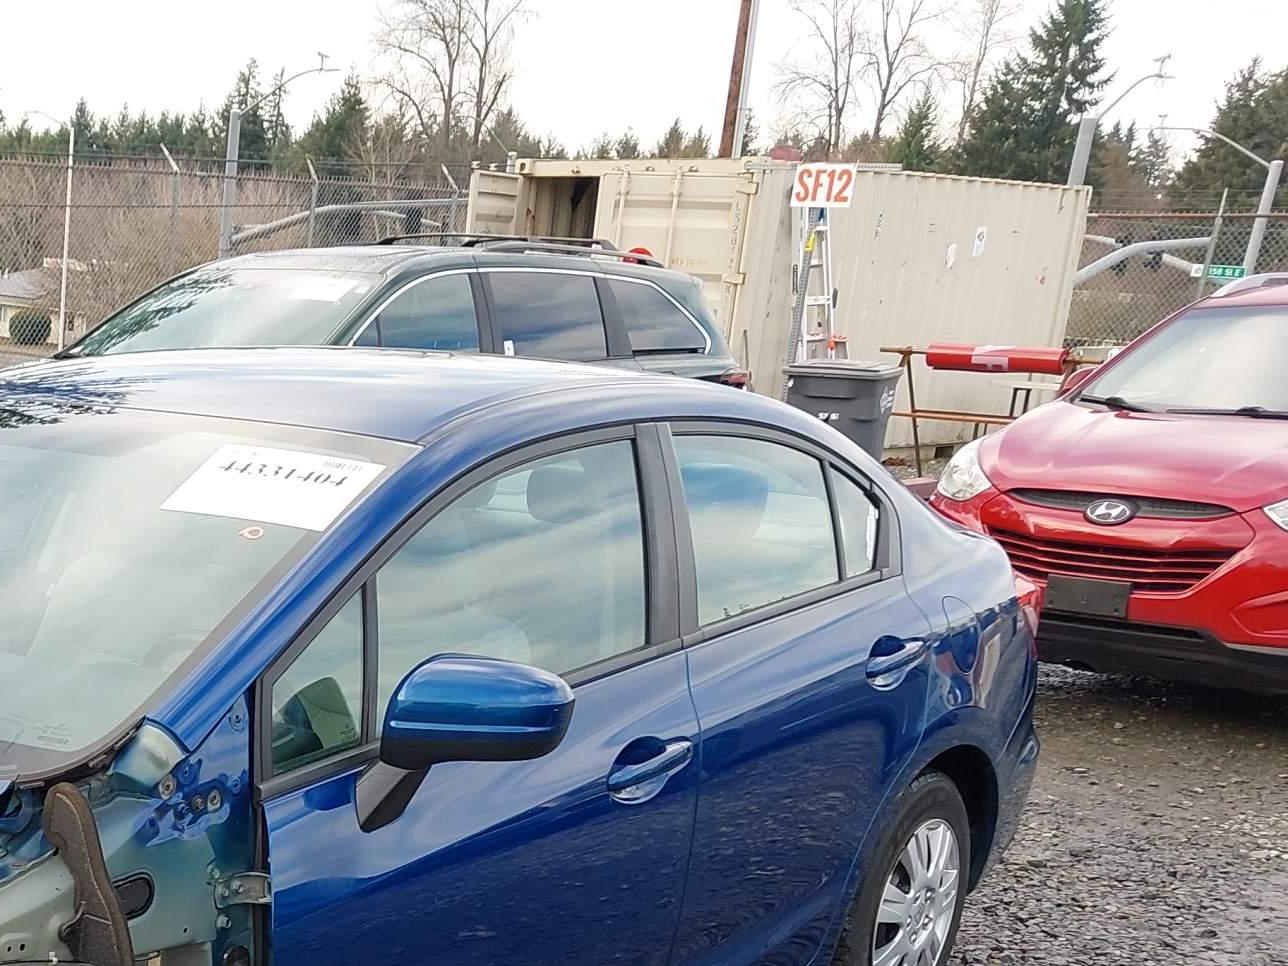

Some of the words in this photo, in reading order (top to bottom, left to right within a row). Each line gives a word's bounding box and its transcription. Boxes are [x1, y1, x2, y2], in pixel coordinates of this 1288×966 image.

[795, 168, 852, 203] SF12
[1234, 268, 1241, 276] E
[218, 458, 349, 487] 44331404
